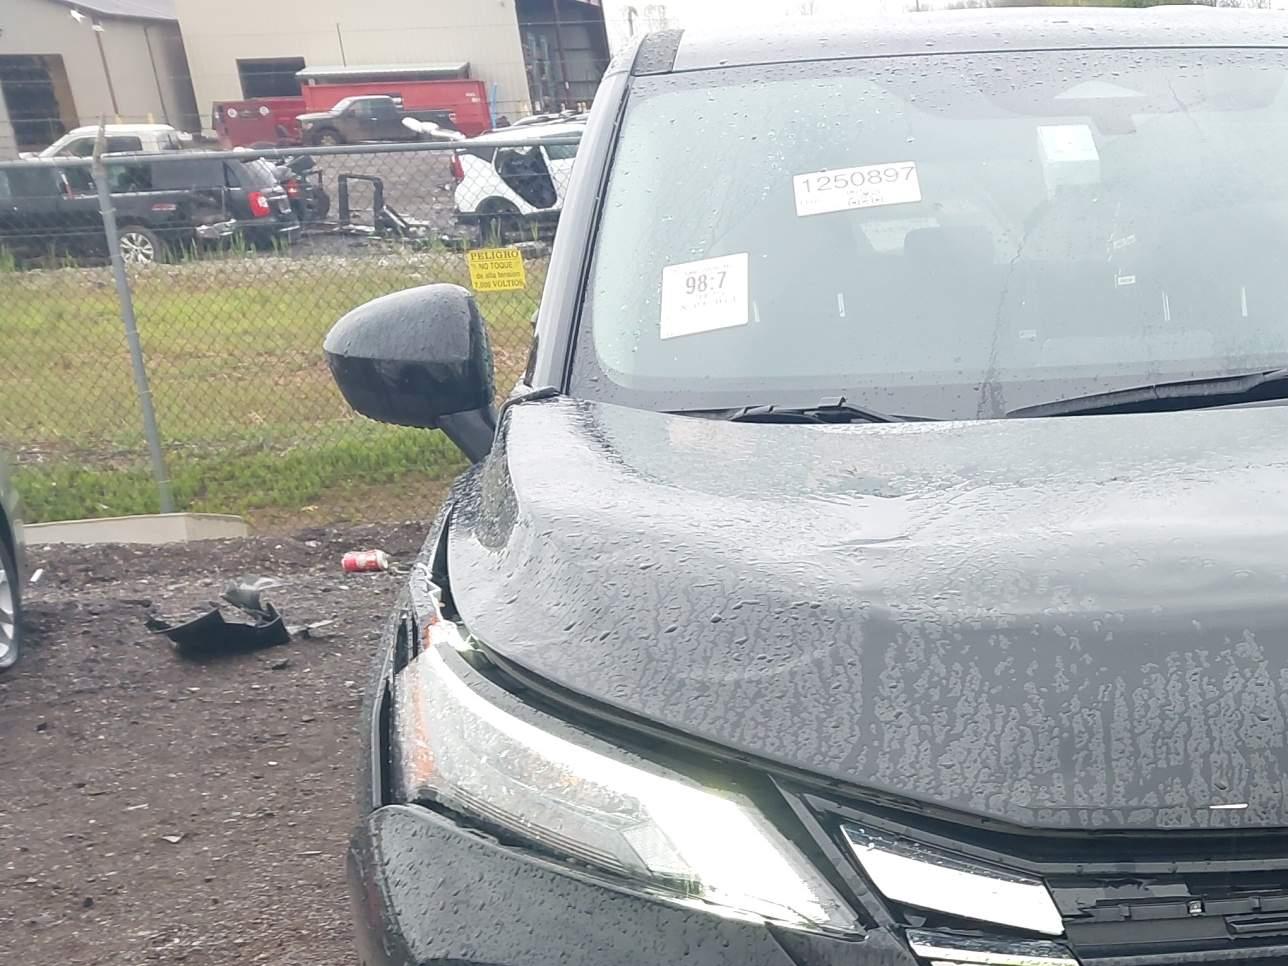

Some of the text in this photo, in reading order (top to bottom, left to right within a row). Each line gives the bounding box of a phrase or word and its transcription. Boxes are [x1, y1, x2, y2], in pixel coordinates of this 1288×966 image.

[802, 166, 914, 193] 1250897
[471, 250, 518, 260] PELIGRO
[490, 261, 513, 270] TOQUE
[685, 272, 727, 294] 98:7
